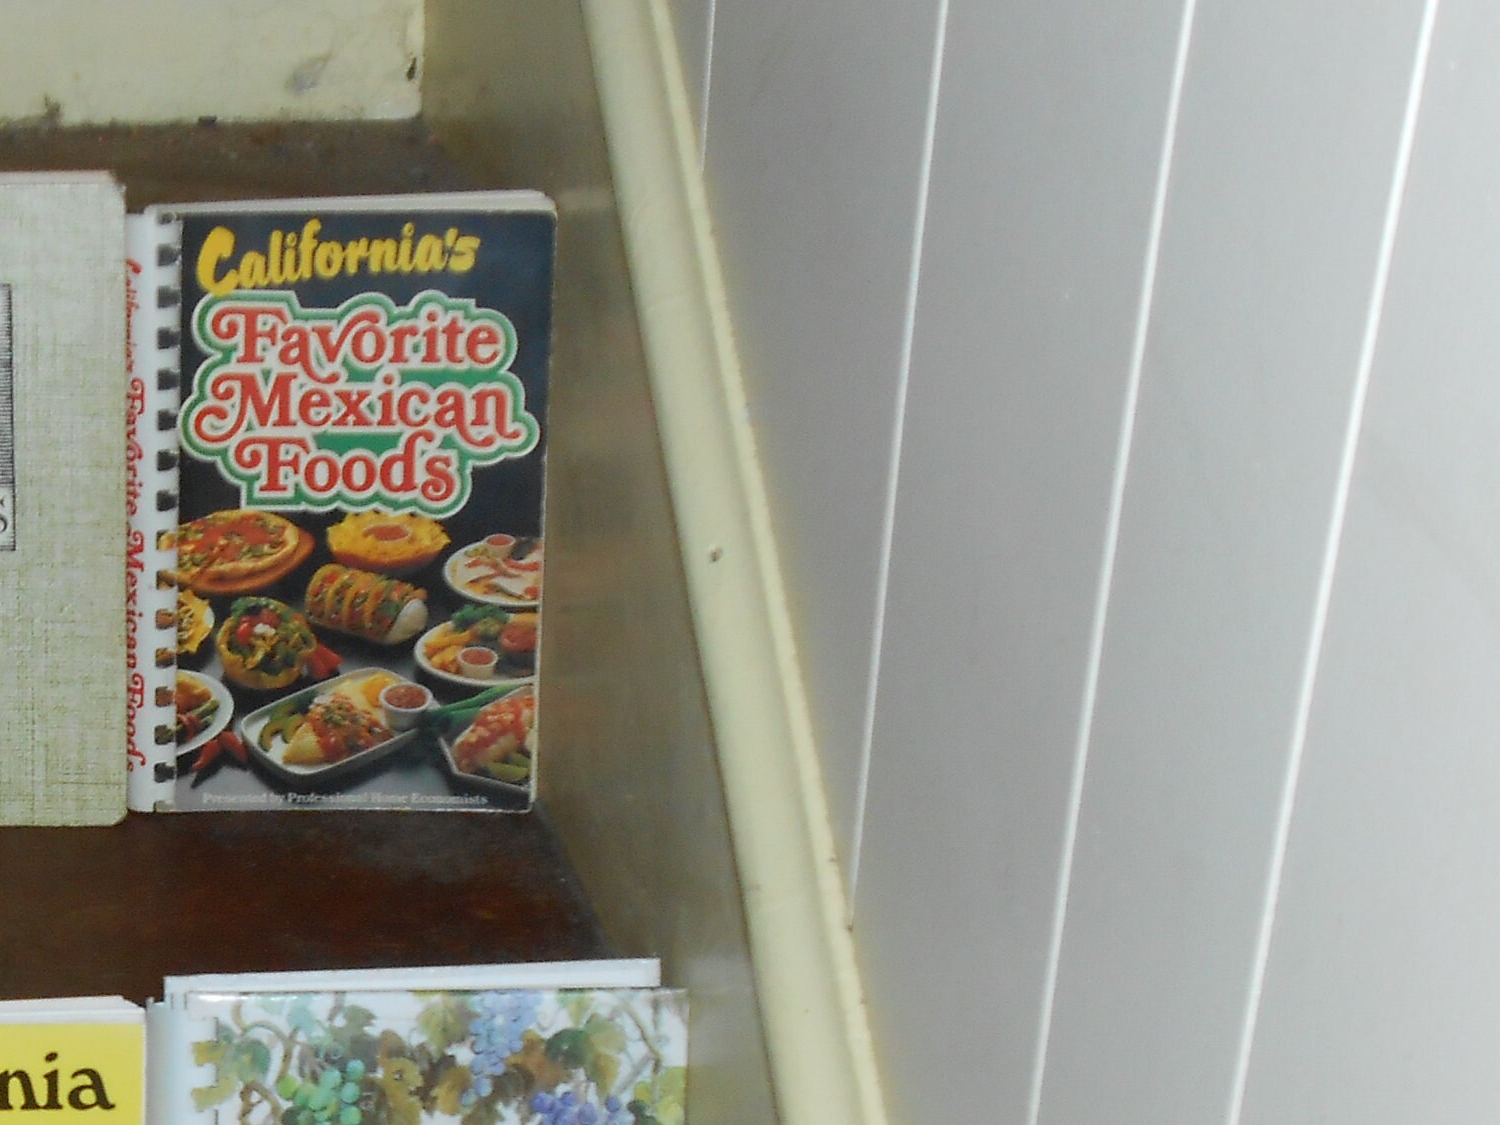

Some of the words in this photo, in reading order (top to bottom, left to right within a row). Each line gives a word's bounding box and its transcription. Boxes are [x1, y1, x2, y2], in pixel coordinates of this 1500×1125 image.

[196, 218, 482, 295] California's
[209, 305, 502, 384] Favorite
[194, 370, 522, 444] Mexican
[234, 429, 457, 502] Foods
[125, 521, 146, 669] Mexican
